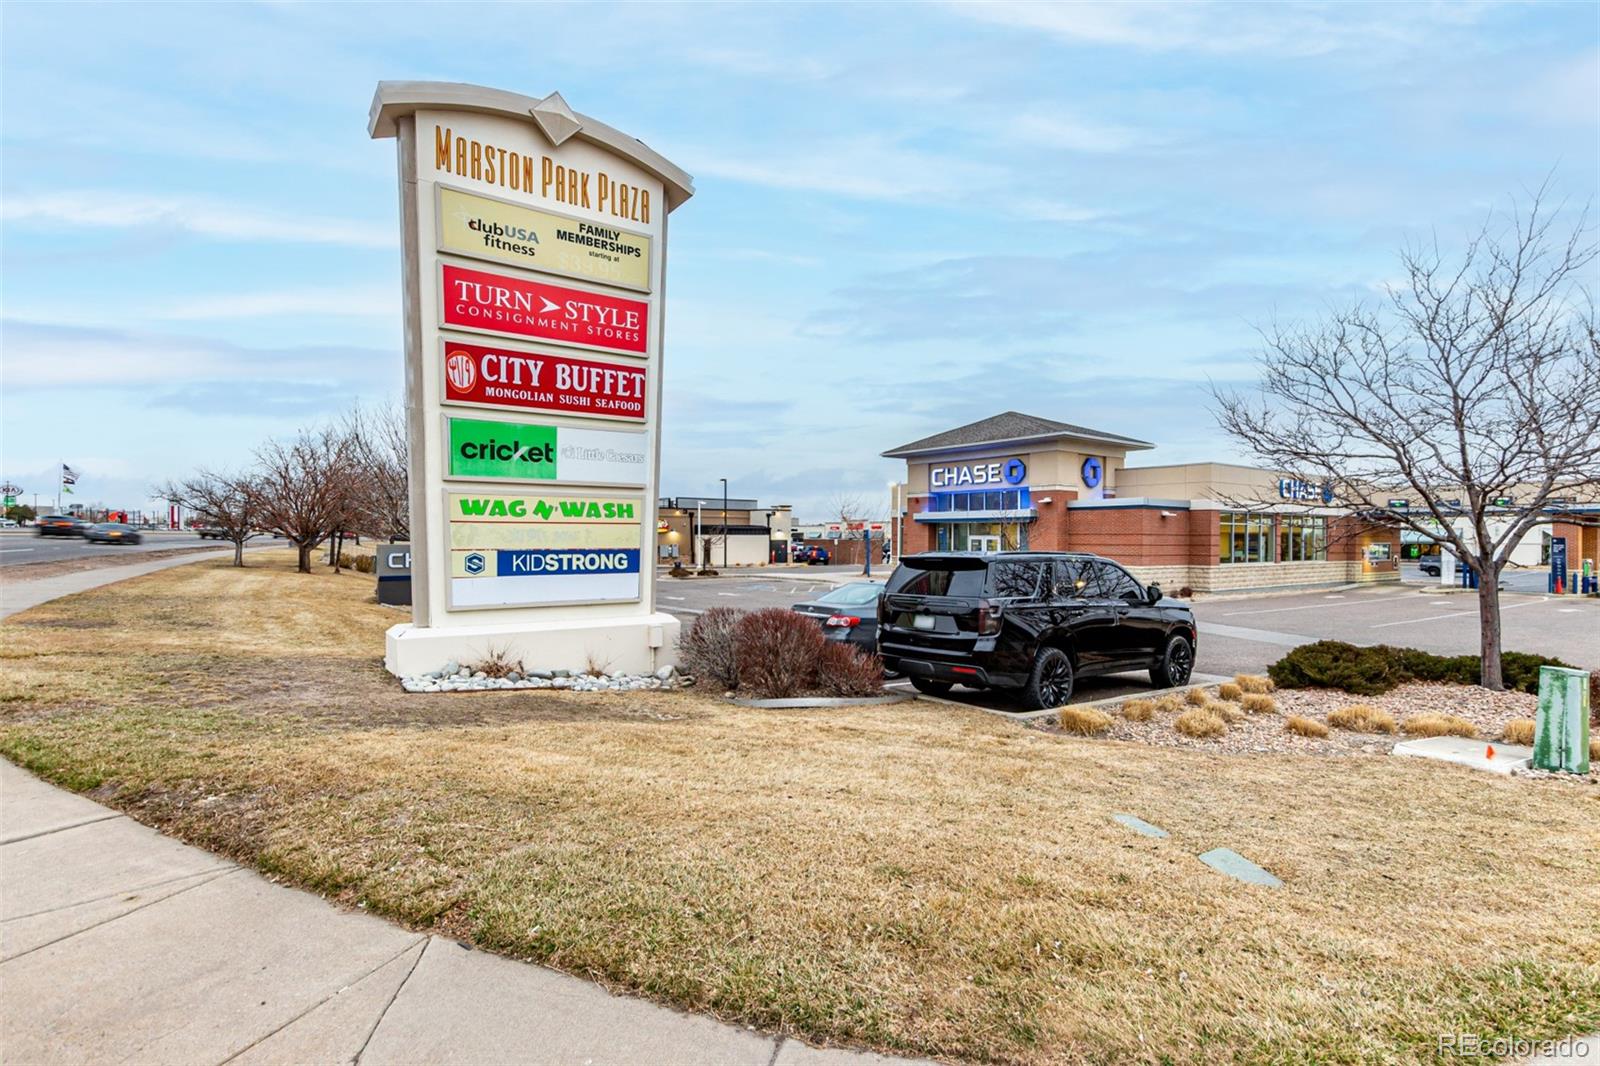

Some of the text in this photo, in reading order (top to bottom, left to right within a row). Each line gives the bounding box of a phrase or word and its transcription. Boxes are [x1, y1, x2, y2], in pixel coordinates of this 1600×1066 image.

[435, 125, 650, 224] MARSTON PARK PLAZA
[468, 218, 539, 244] clubUSA
[556, 229, 641, 258] MEMBERSHIPS
[579, 223, 621, 241] FAMILY
[483, 233, 536, 257] fitness
[588, 250, 612, 262] starting
[454, 279, 640, 330] TURN STYLE
[456, 304, 639, 342] CONSIGNMENT STORES
[481, 354, 646, 398] CITY BUFFET
[485, 386, 641, 412] MONGOLIAN SUSHI SEAFOOD
[460, 439, 554, 464] cricket
[931, 463, 1002, 487] CHASE
[459, 499, 527, 518] WAG
[559, 501, 634, 519] WASH
[513, 554, 628, 572] KIDSTRONG
